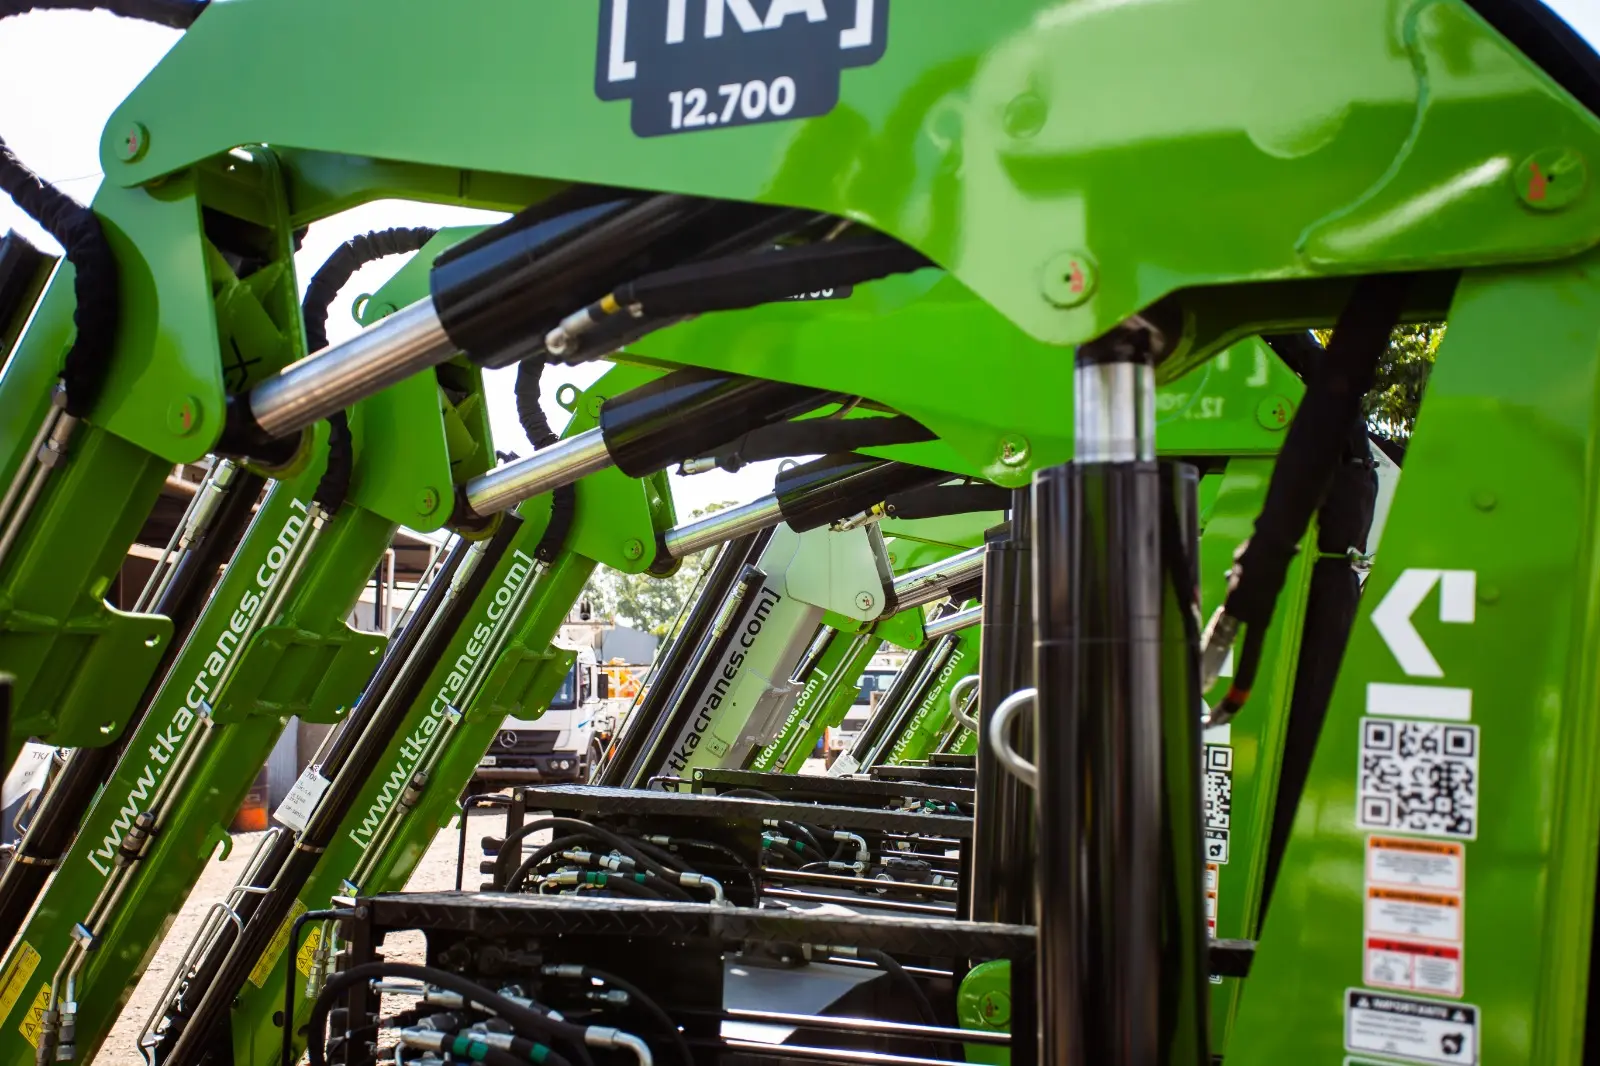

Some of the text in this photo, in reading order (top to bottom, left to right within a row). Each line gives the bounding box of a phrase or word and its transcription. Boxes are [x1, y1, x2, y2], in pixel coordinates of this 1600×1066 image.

[668, 76, 797, 129] 12.700
[87, 497, 309, 877] [www.tkacranes.com]
[348, 549, 534, 850] [www.tkacranes.com]
